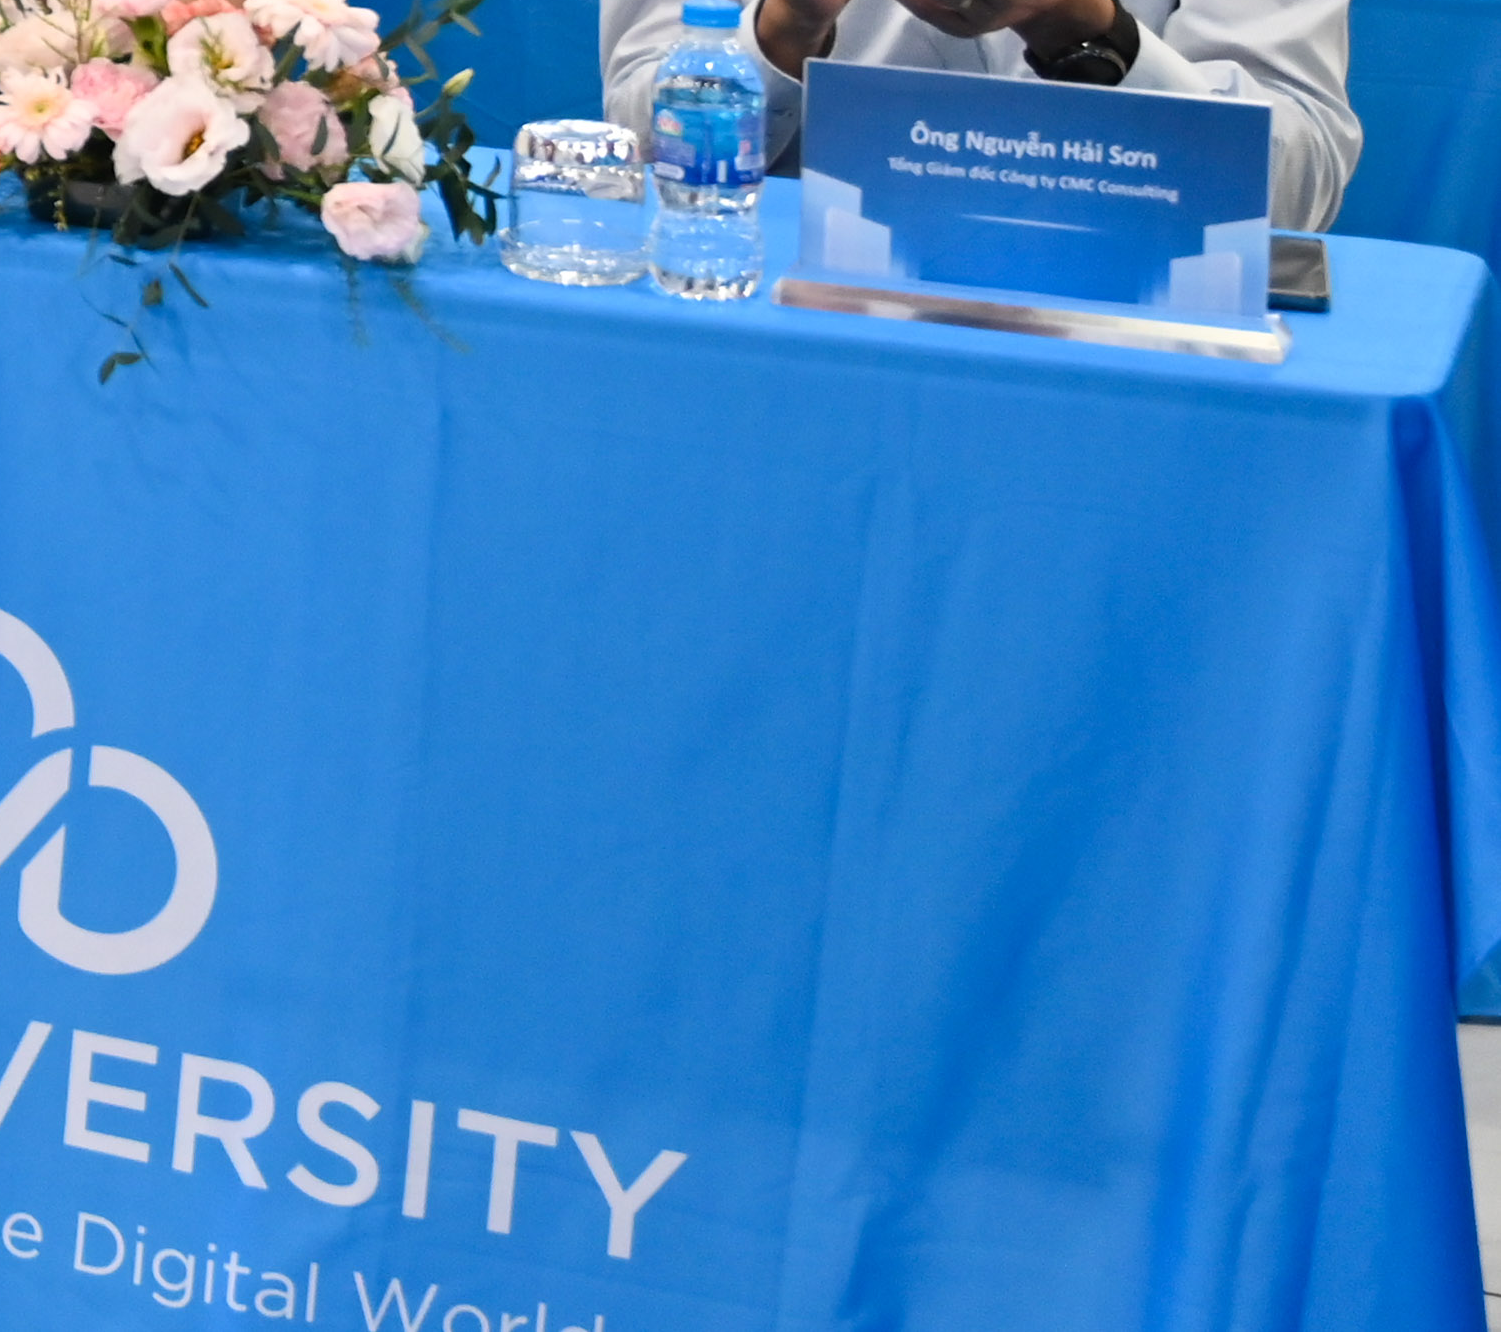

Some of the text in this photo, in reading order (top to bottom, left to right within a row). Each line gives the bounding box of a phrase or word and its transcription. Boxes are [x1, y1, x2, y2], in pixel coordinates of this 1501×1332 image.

[910, 120, 1157, 170] Ông Nguyễn Hải Sơn
[1058, 174, 1096, 192] CMC
[1097, 178, 1180, 205] Consulting
[73, 1211, 319, 1322] Digital
